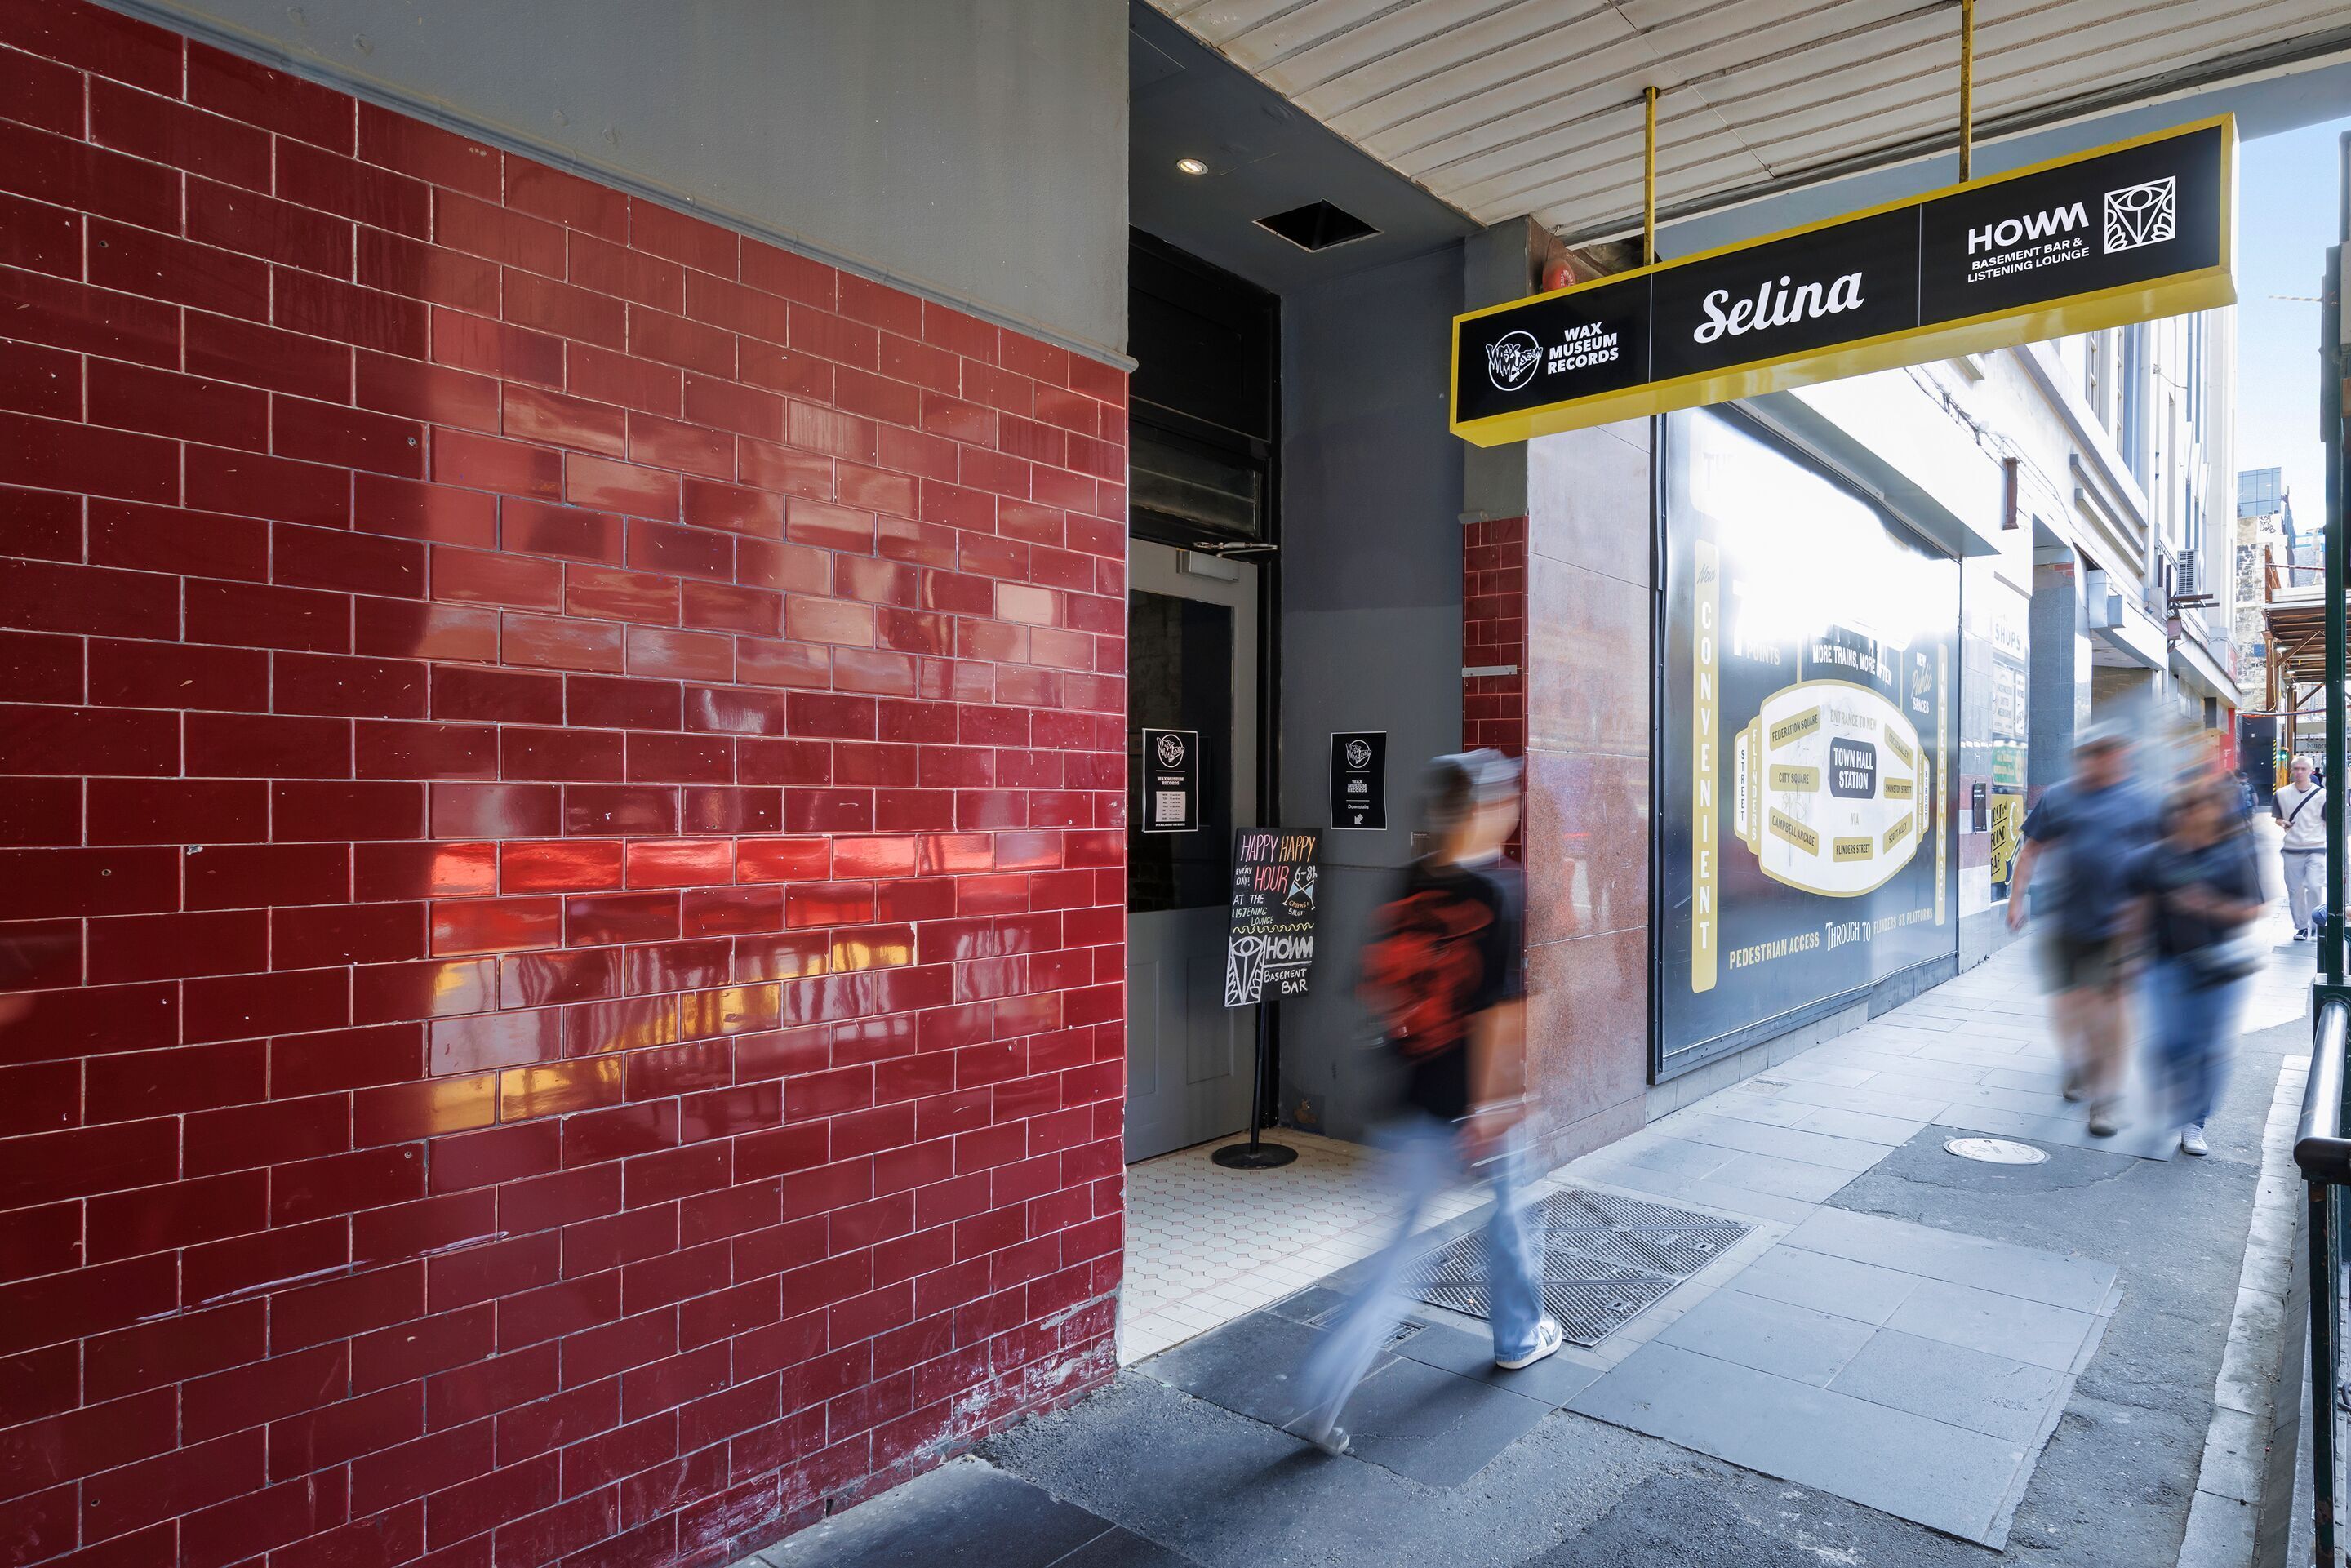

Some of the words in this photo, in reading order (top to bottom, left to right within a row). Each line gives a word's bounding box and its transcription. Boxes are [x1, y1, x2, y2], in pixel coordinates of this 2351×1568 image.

[1967, 202, 2090, 255] HOWM
[1967, 260, 2033, 283] LISTENING
[2035, 247, 2090, 268] LOUNGE
[1971, 246, 2042, 271] BASEMENT
[2043, 239, 2070, 255] BAR
[2073, 237, 2082, 247] &
[1693, 272, 1864, 344] Selina
[1564, 321, 1602, 342] WAX
[1549, 332, 1618, 360] MUSEUM
[1547, 347, 1619, 375] RECORDS
[1994, 623, 2020, 651] SHOPS
[1747, 640, 1781, 666] POINTS
[1812, 644, 1833, 664] MORE
[1833, 646, 1858, 670] TRAINS,
[1860, 655, 1876, 676] MORE
[1913, 698, 1930, 714] SPACES
[1772, 722, 1800, 743] FEDERATION
[1801, 713, 1819, 730] SQUARE
[1830, 710, 1859, 728] ENTRANCE
[1860, 715, 1866, 729] TO
[1833, 748, 1855, 768] TOWN
[1856, 751, 1873, 771] HALL
[1700, 601, 1712, 949] CONVENIENT
[1779, 772, 1790, 783] CITY
[1791, 773, 1809, 784] SQUARE
[1838, 771, 1869, 790] STATION
[1851, 812, 1859, 825] VIA
[1772, 815, 1797, 837] CAMPBELL
[1798, 830, 1815, 847] ARCADE
[1240, 834, 1278, 862] HAPPY
[1278, 835, 1316, 862] HAPPY
[1836, 845, 1855, 855] FLINDERS
[1856, 843, 1870, 855] STREET
[1235, 866, 1252, 875] EVERY
[1254, 865, 1289, 894] HOUR
[1294, 865, 1318, 882] 6-8h
[1233, 894, 1245, 906] AT
[1250, 894, 1264, 904] THE
[1232, 907, 1268, 918] LISTENING
[1251, 916, 1274, 926] LOUNGE
[1729, 937, 1787, 970] PEDESTRIAN
[1789, 931, 1820, 954] ACCESS
[1861, 922, 1871, 942] TO
[1873, 915, 1896, 935] FLINDERS
[1898, 913, 1906, 927] ST.
[1906, 907, 1933, 925] PLATFORMS
[1264, 968, 1307, 983] BASEMENT
[1282, 979, 1308, 994] BAR
